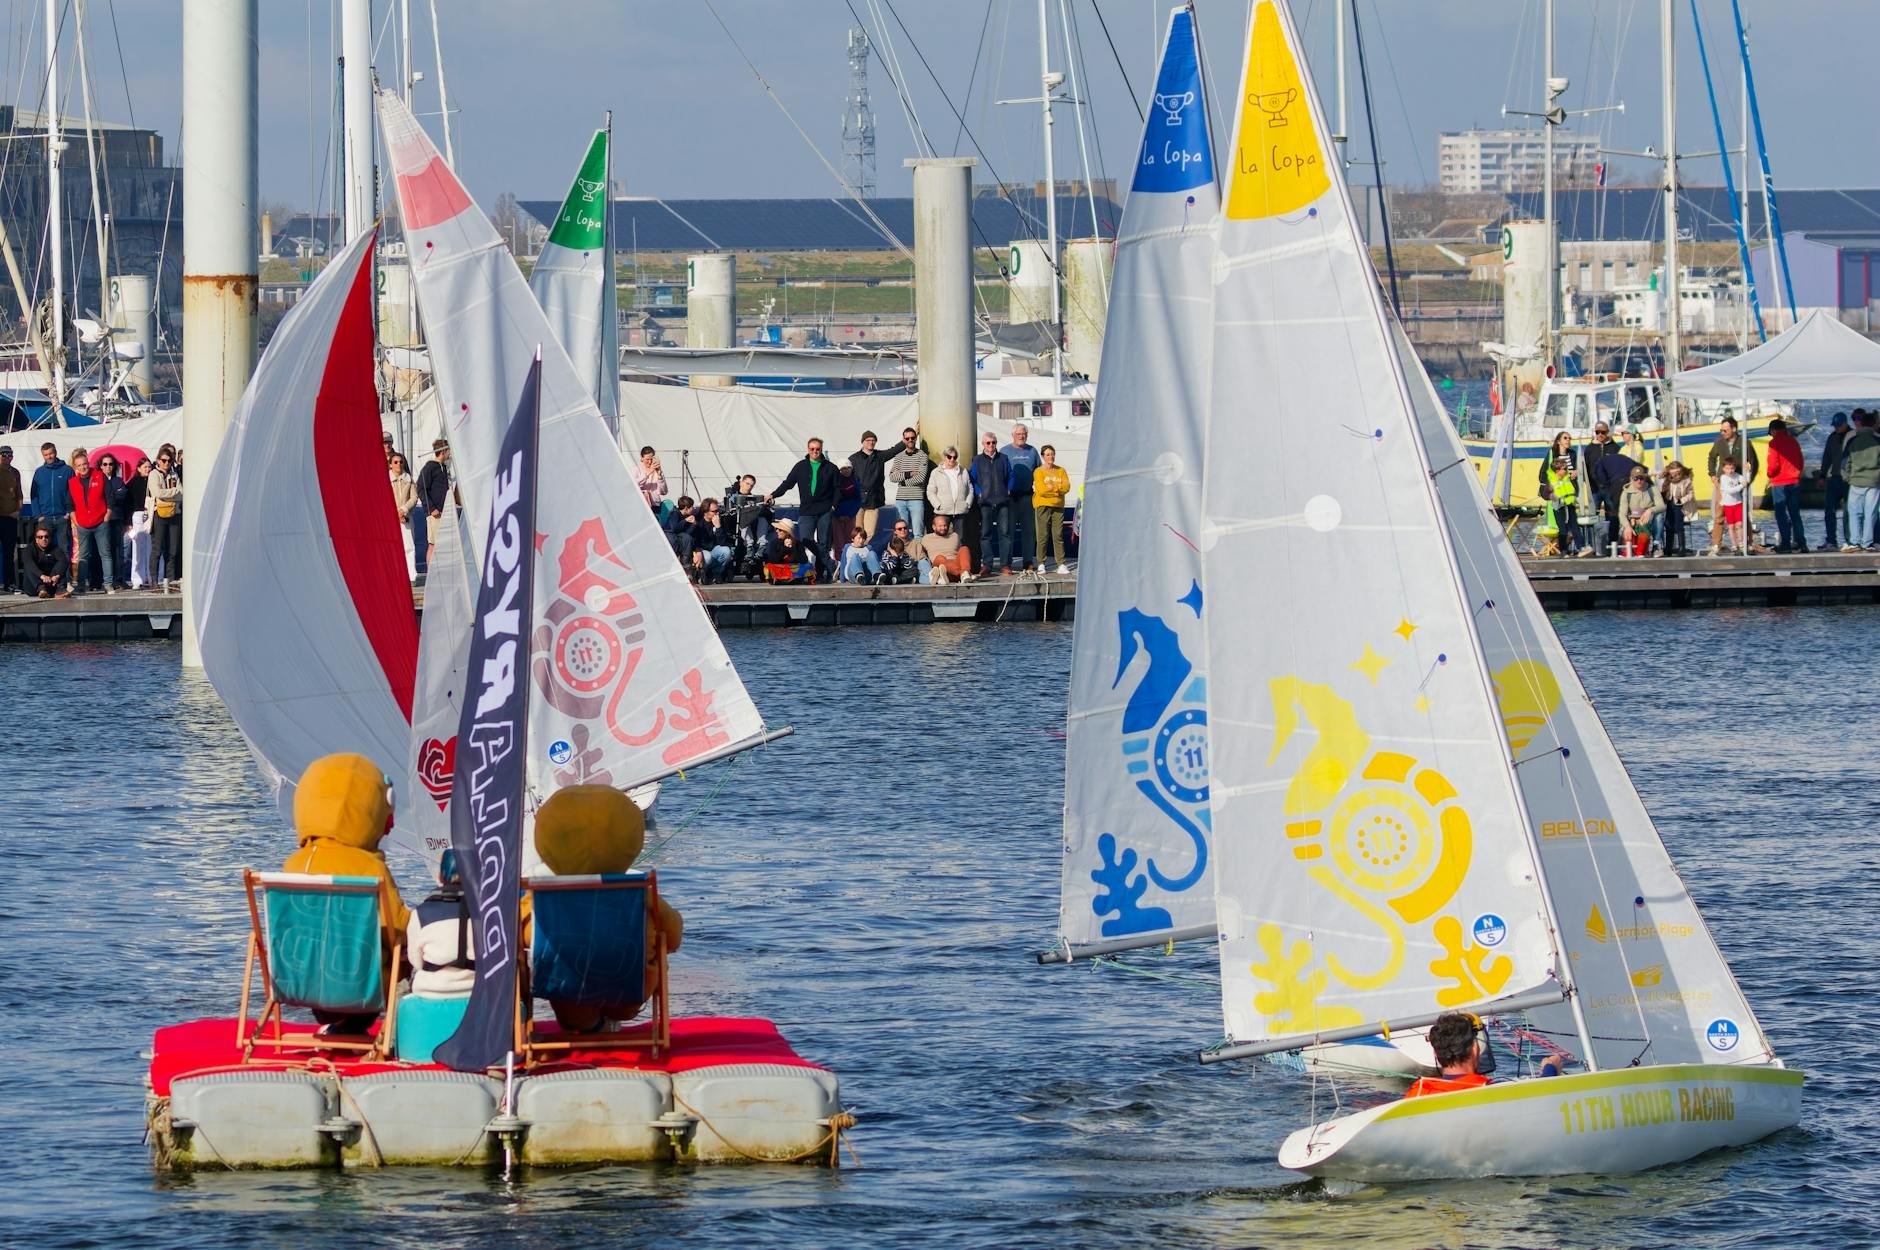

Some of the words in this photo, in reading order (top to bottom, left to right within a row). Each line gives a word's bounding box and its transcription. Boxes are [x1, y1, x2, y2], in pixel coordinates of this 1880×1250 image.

[1184, 746, 1203, 769] 11
[1482, 917, 1493, 928] N
[1487, 933, 1496, 943] S
[1717, 1022, 1728, 1033] N
[1719, 1038, 1728, 1047] S
[1560, 1095, 1616, 1136] 11TH
[1619, 1089, 1676, 1128] HOUR
[1677, 1086, 1735, 1122] RACING
